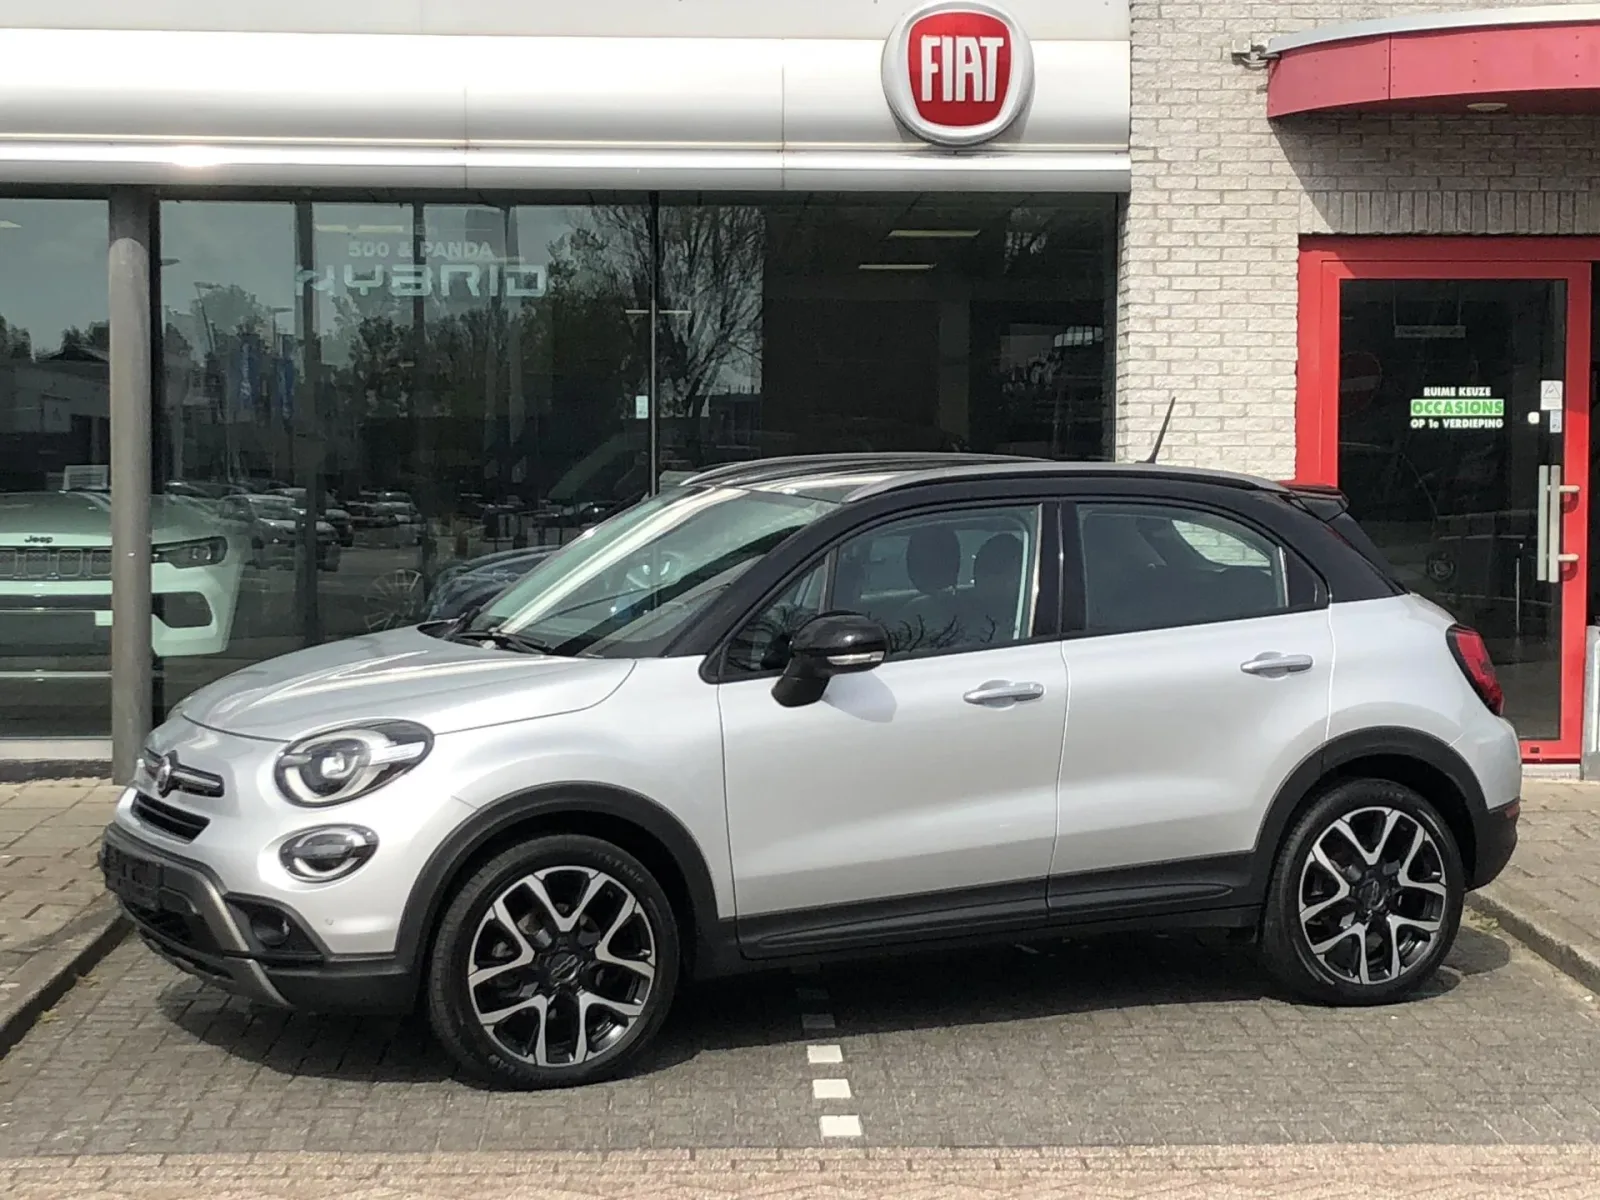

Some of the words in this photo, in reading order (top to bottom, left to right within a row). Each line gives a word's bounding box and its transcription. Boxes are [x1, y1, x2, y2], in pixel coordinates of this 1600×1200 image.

[921, 34, 1004, 102] FIAT
[348, 241, 390, 257] 500
[420, 241, 494, 259] PANDA
[296, 264, 547, 297] HYBRID
[1424, 387, 1456, 397] RUIME
[1458, 387, 1491, 397] KEUZE
[1412, 400, 1503, 414] OCCASIONS
[1410, 418, 1425, 429] OP
[1443, 418, 1503, 429] VERDIEPING
[24, 535, 53, 544] Jeep
